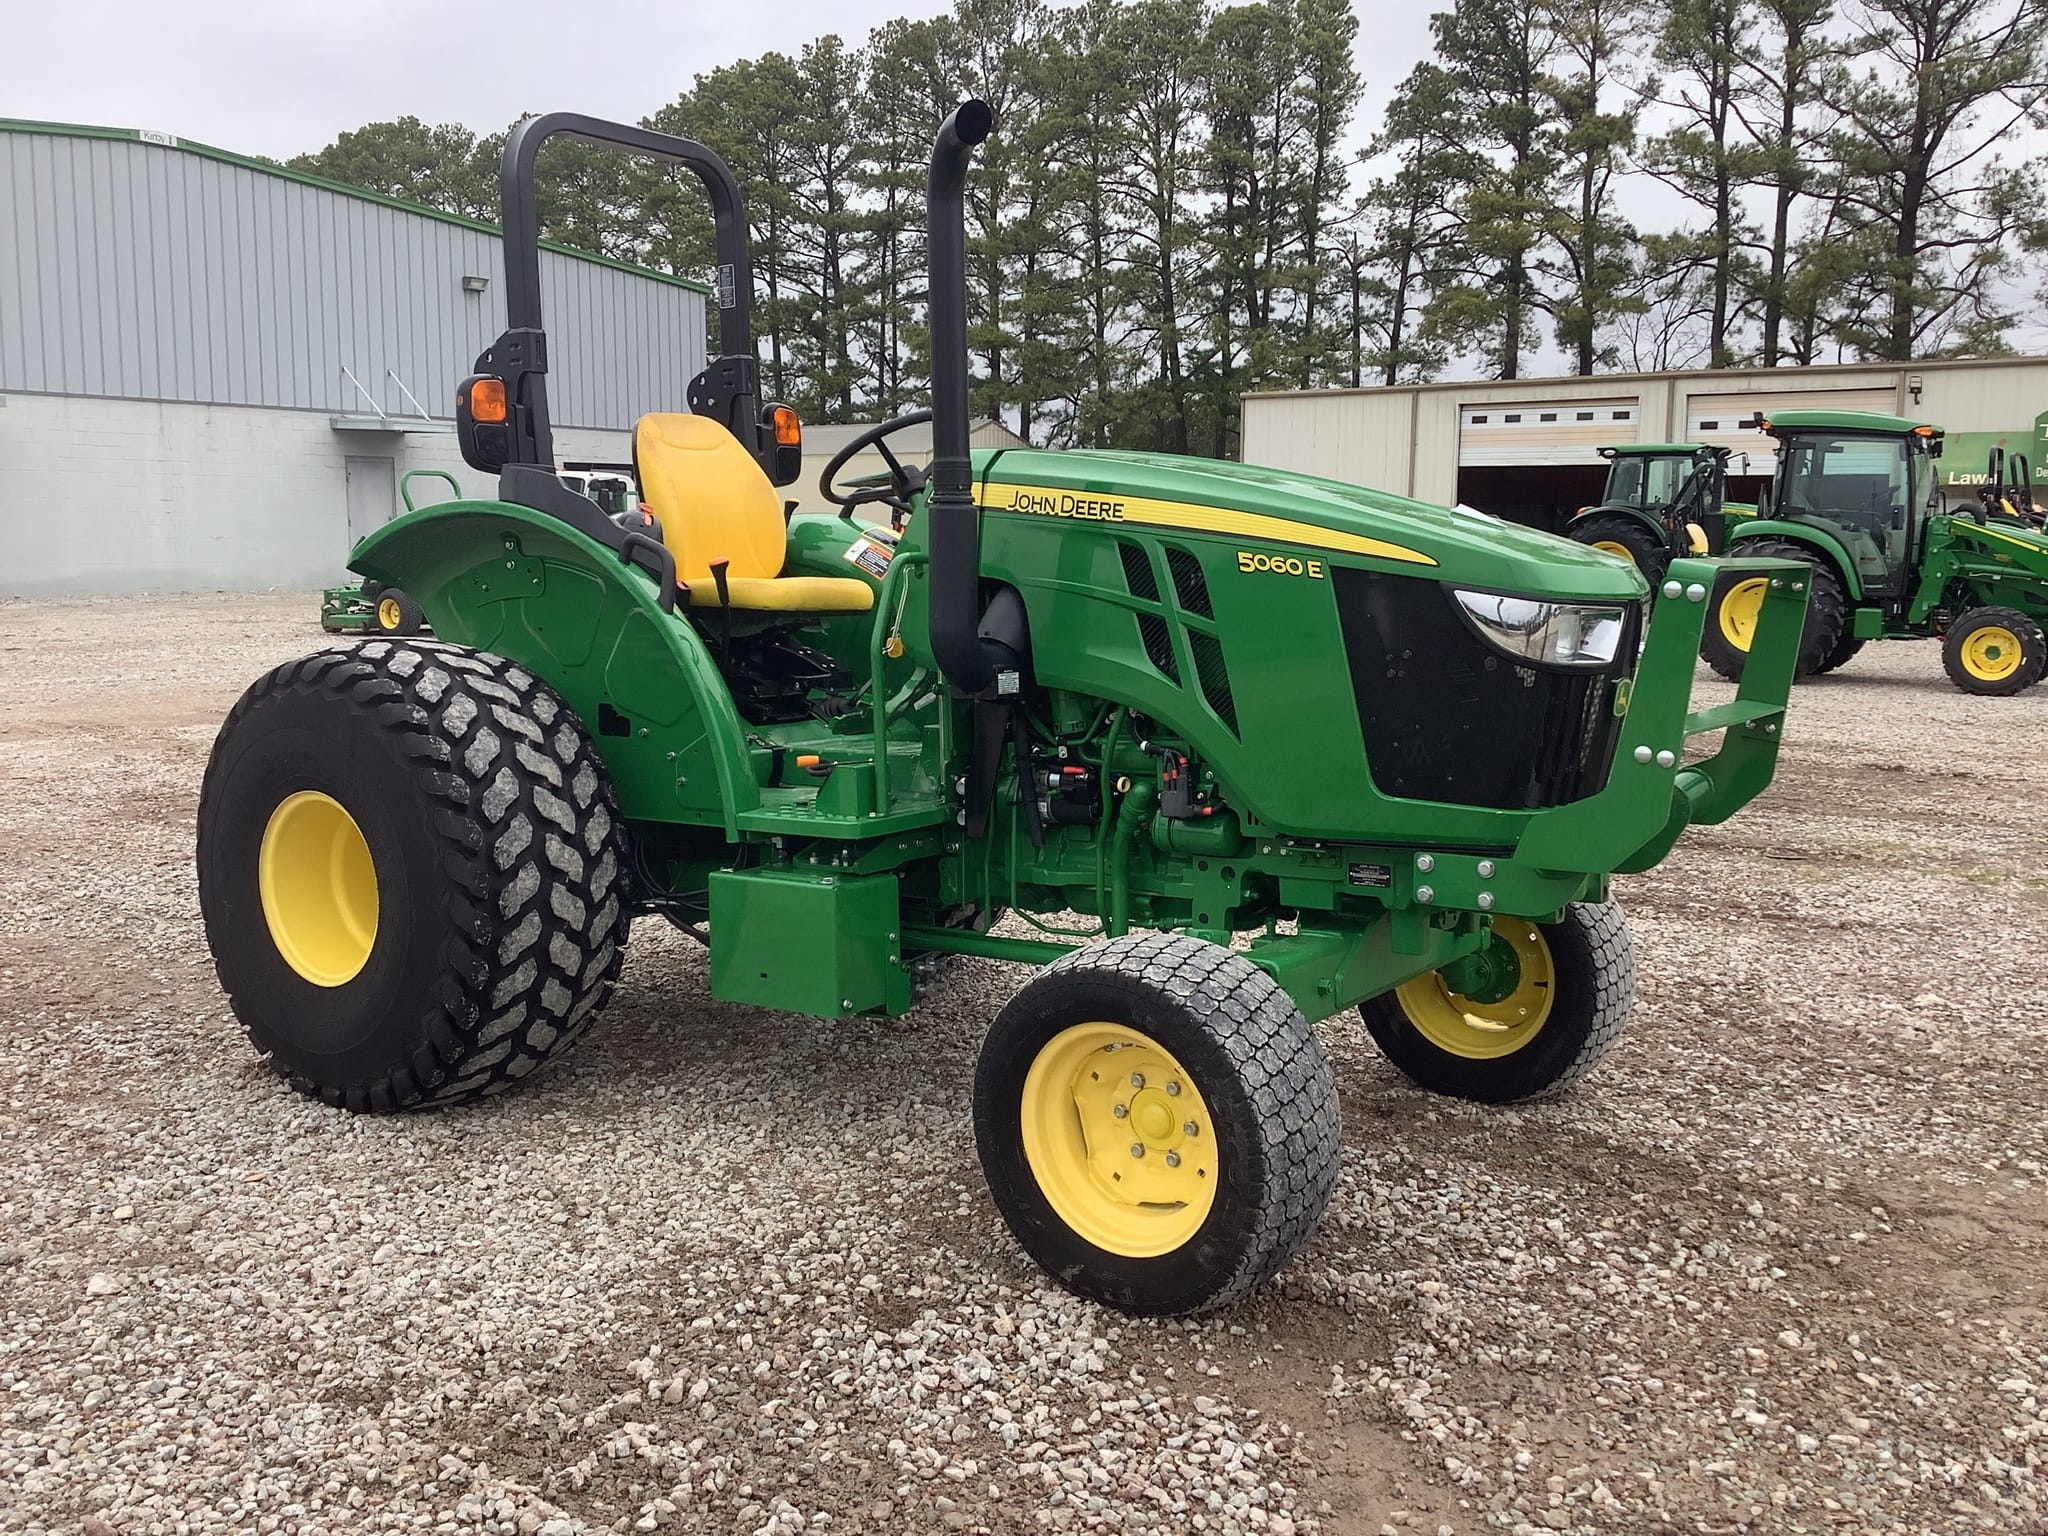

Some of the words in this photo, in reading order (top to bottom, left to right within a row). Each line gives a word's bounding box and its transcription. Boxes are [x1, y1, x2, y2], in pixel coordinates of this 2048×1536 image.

[1008, 490, 1056, 513] JOHN
[1060, 494, 1124, 519] DEERE
[1237, 551, 1304, 576] 5060
[1306, 559, 1324, 579] E
